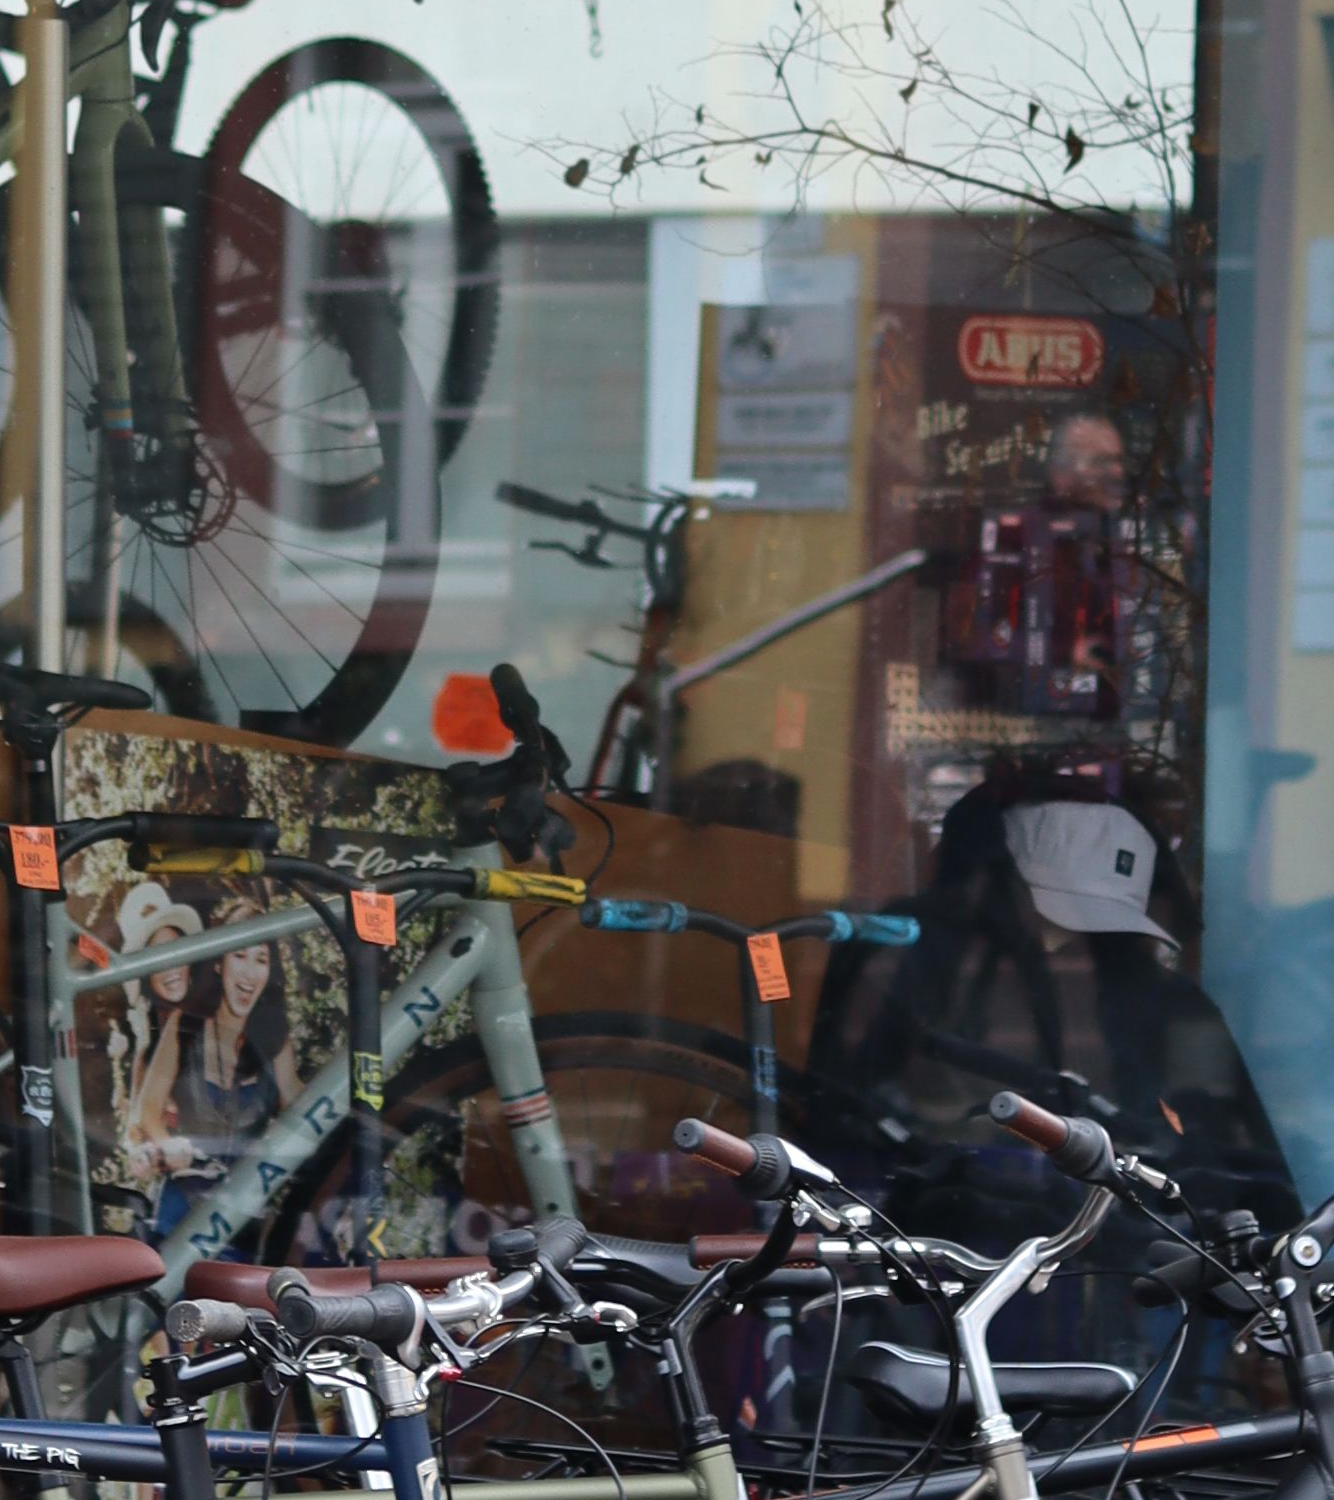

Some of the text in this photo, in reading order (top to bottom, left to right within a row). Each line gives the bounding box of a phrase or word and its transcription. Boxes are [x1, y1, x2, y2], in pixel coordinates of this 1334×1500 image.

[976, 330, 1082, 371] ABUS
[188, 984, 445, 1259] MARN
[1, 1442, 82, 1471] THE PIG
